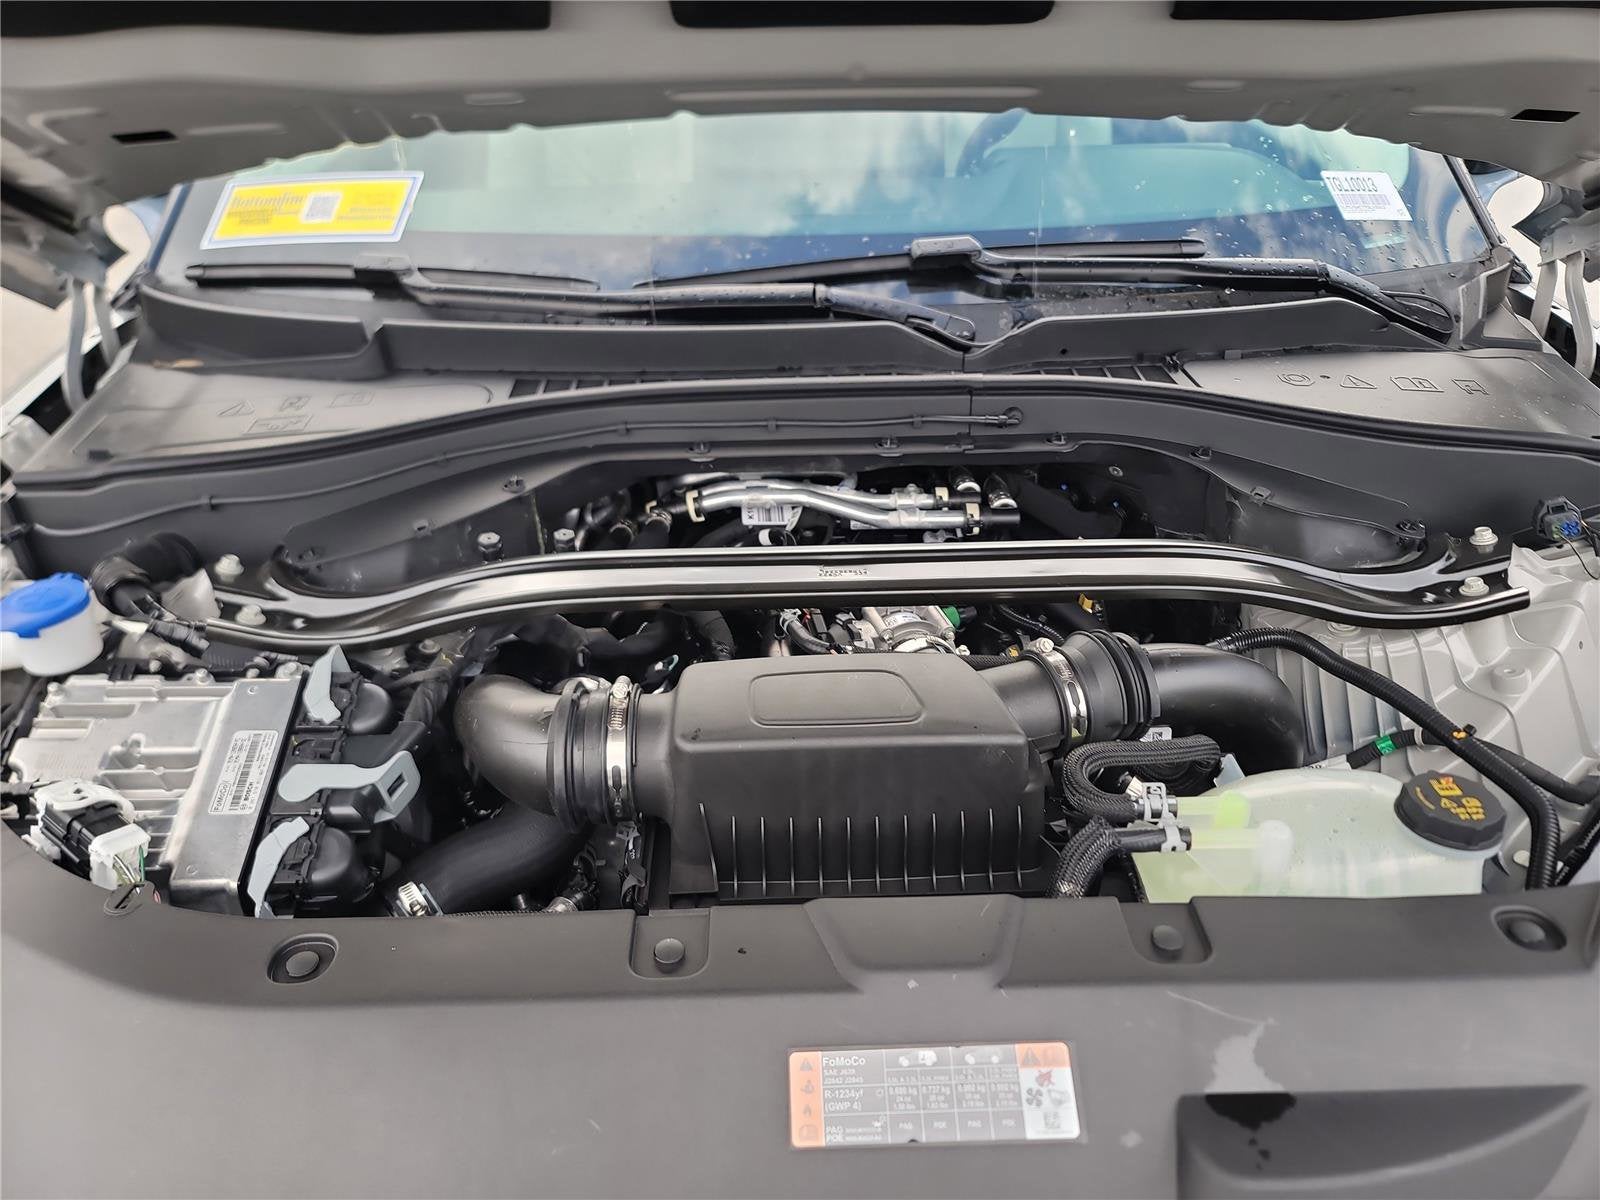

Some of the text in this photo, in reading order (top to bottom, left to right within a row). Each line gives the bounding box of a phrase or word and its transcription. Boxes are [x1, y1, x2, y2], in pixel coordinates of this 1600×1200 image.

[1325, 176, 1378, 193] TGL10013
[213, 783, 229, 811] FoMoCo
[822, 1056, 866, 1067] FoMoCo
[824, 1087, 864, 1100] R-1234yf
[824, 1101, 863, 1113] (GWP 4)
